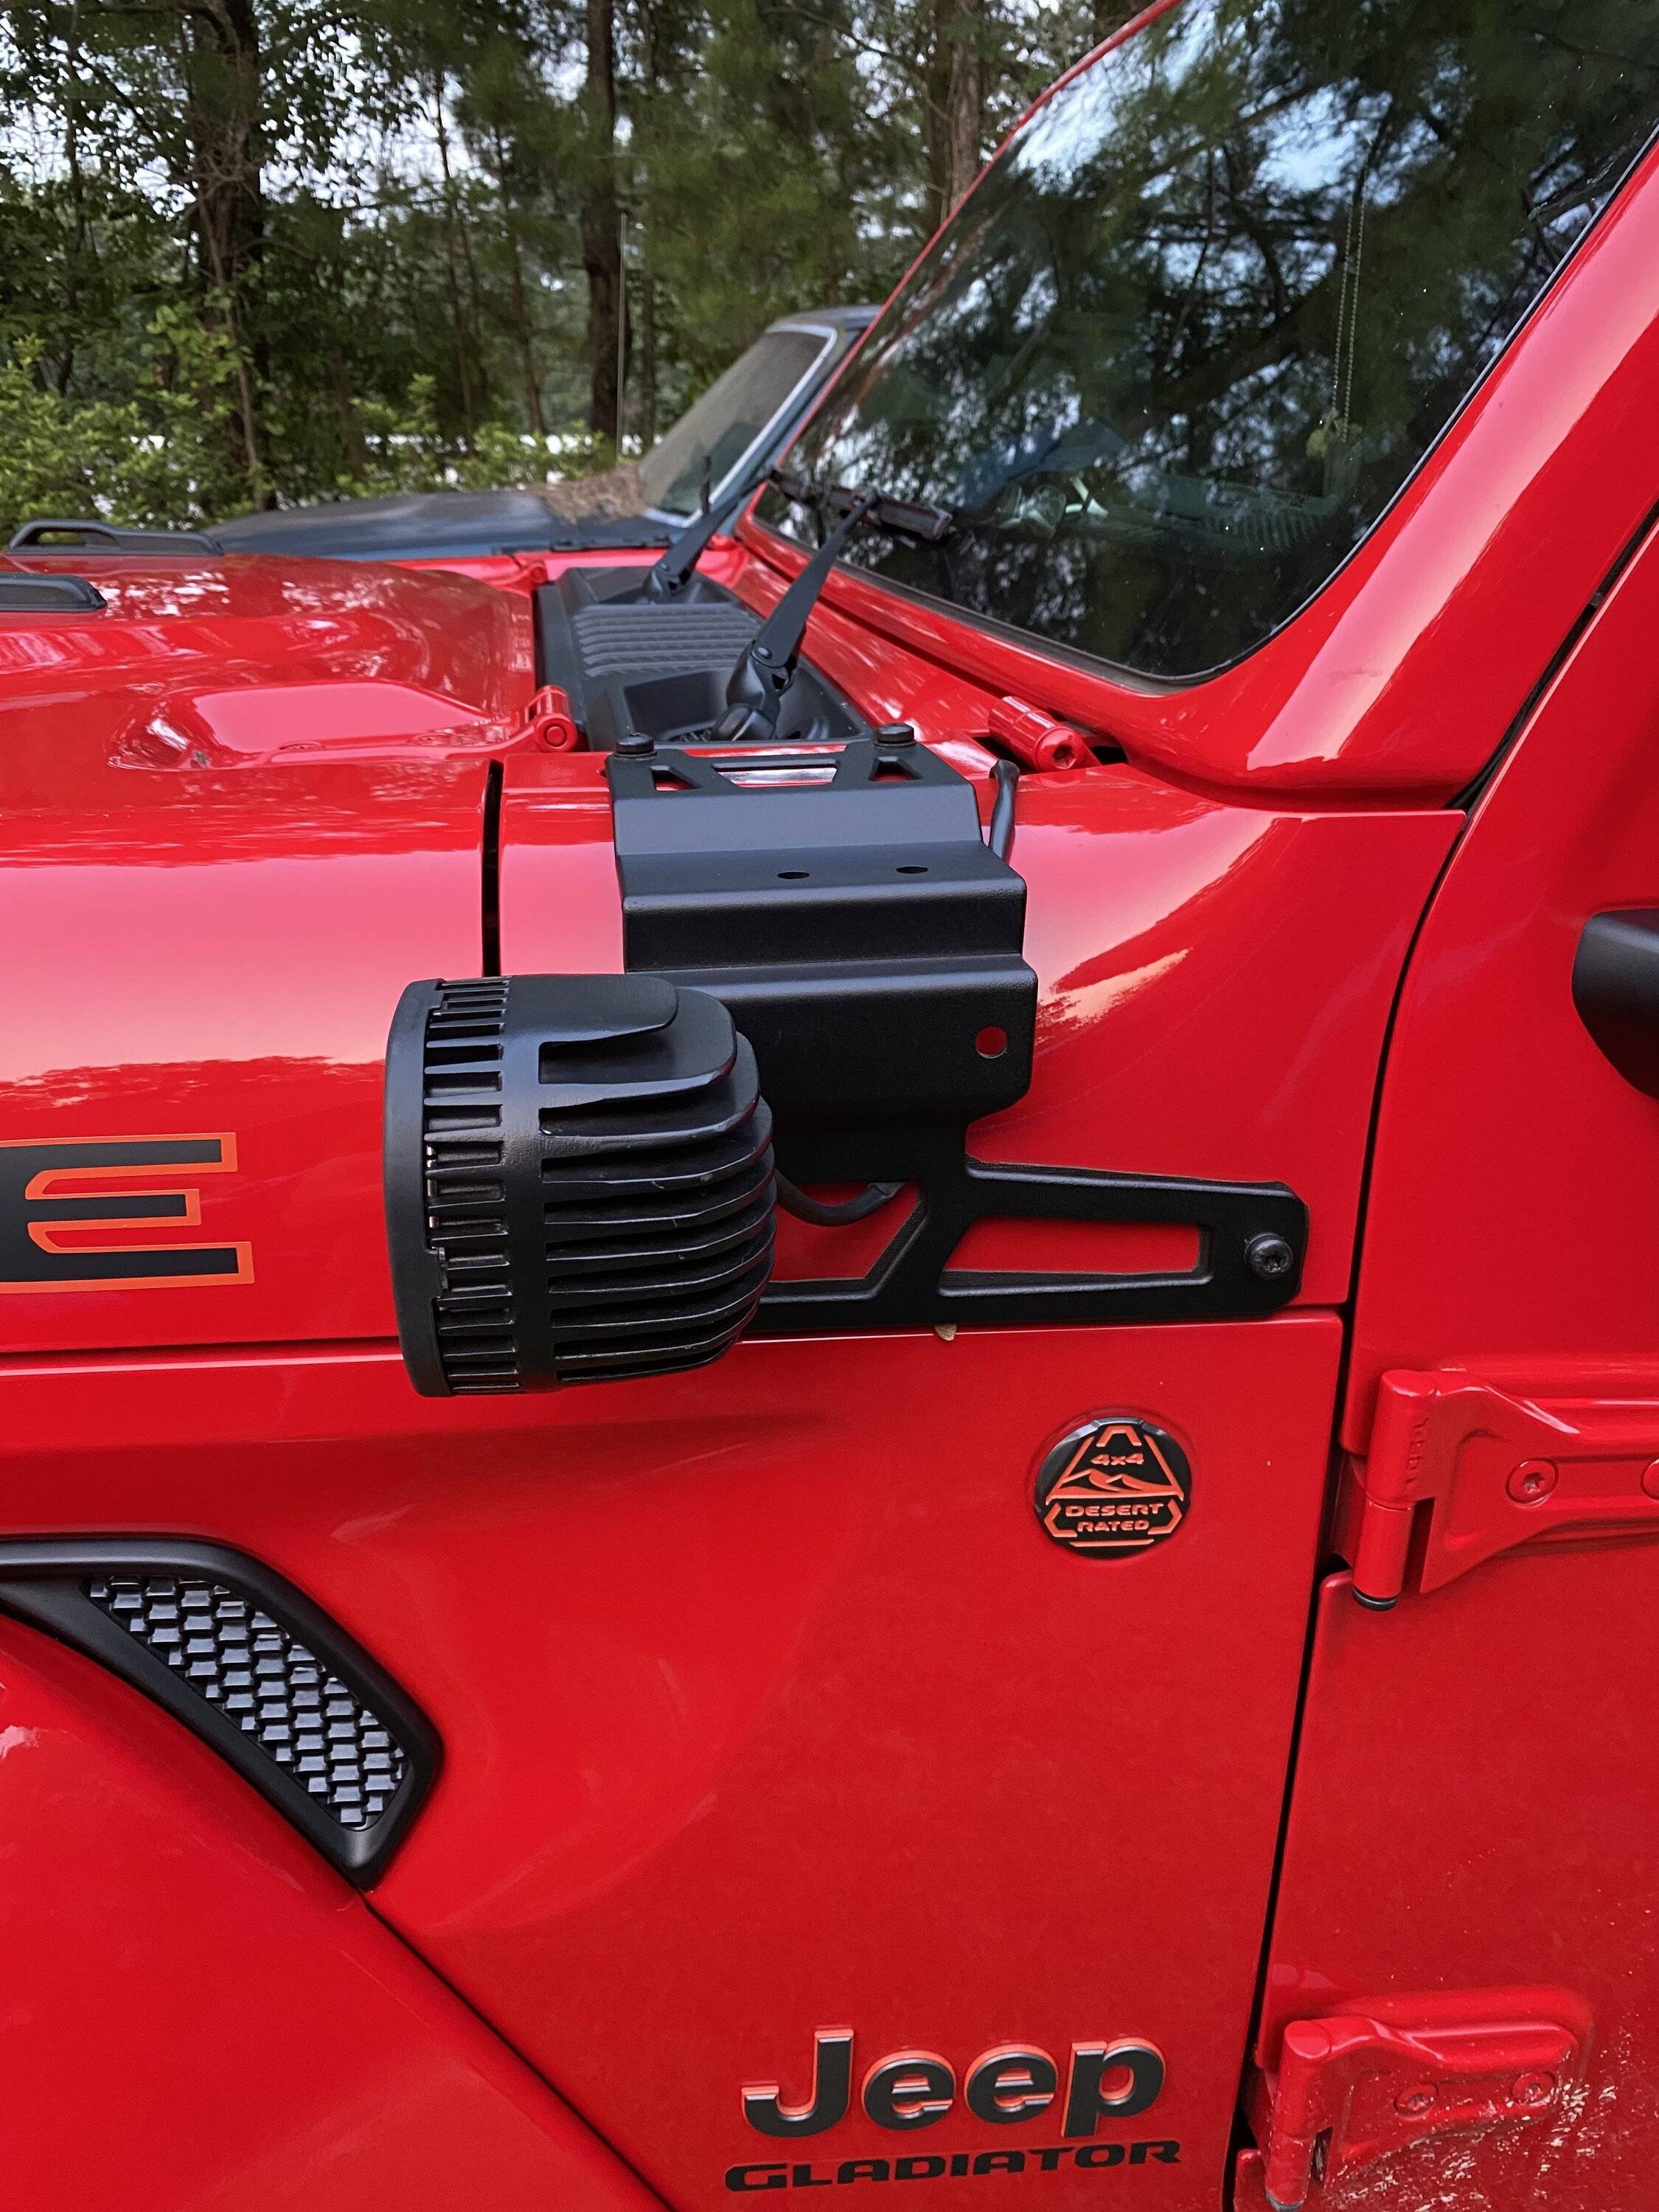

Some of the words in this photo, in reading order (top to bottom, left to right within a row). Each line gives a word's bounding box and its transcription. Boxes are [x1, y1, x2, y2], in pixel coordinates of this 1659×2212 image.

[1091, 1453, 1144, 1465] 4x4
[1066, 1503, 1164, 1517] DESERT
[1077, 1520, 1150, 1532] RATED
[741, 2028, 1166, 2138] Jeep
[724, 2140, 1183, 2192] GLADIATOR
